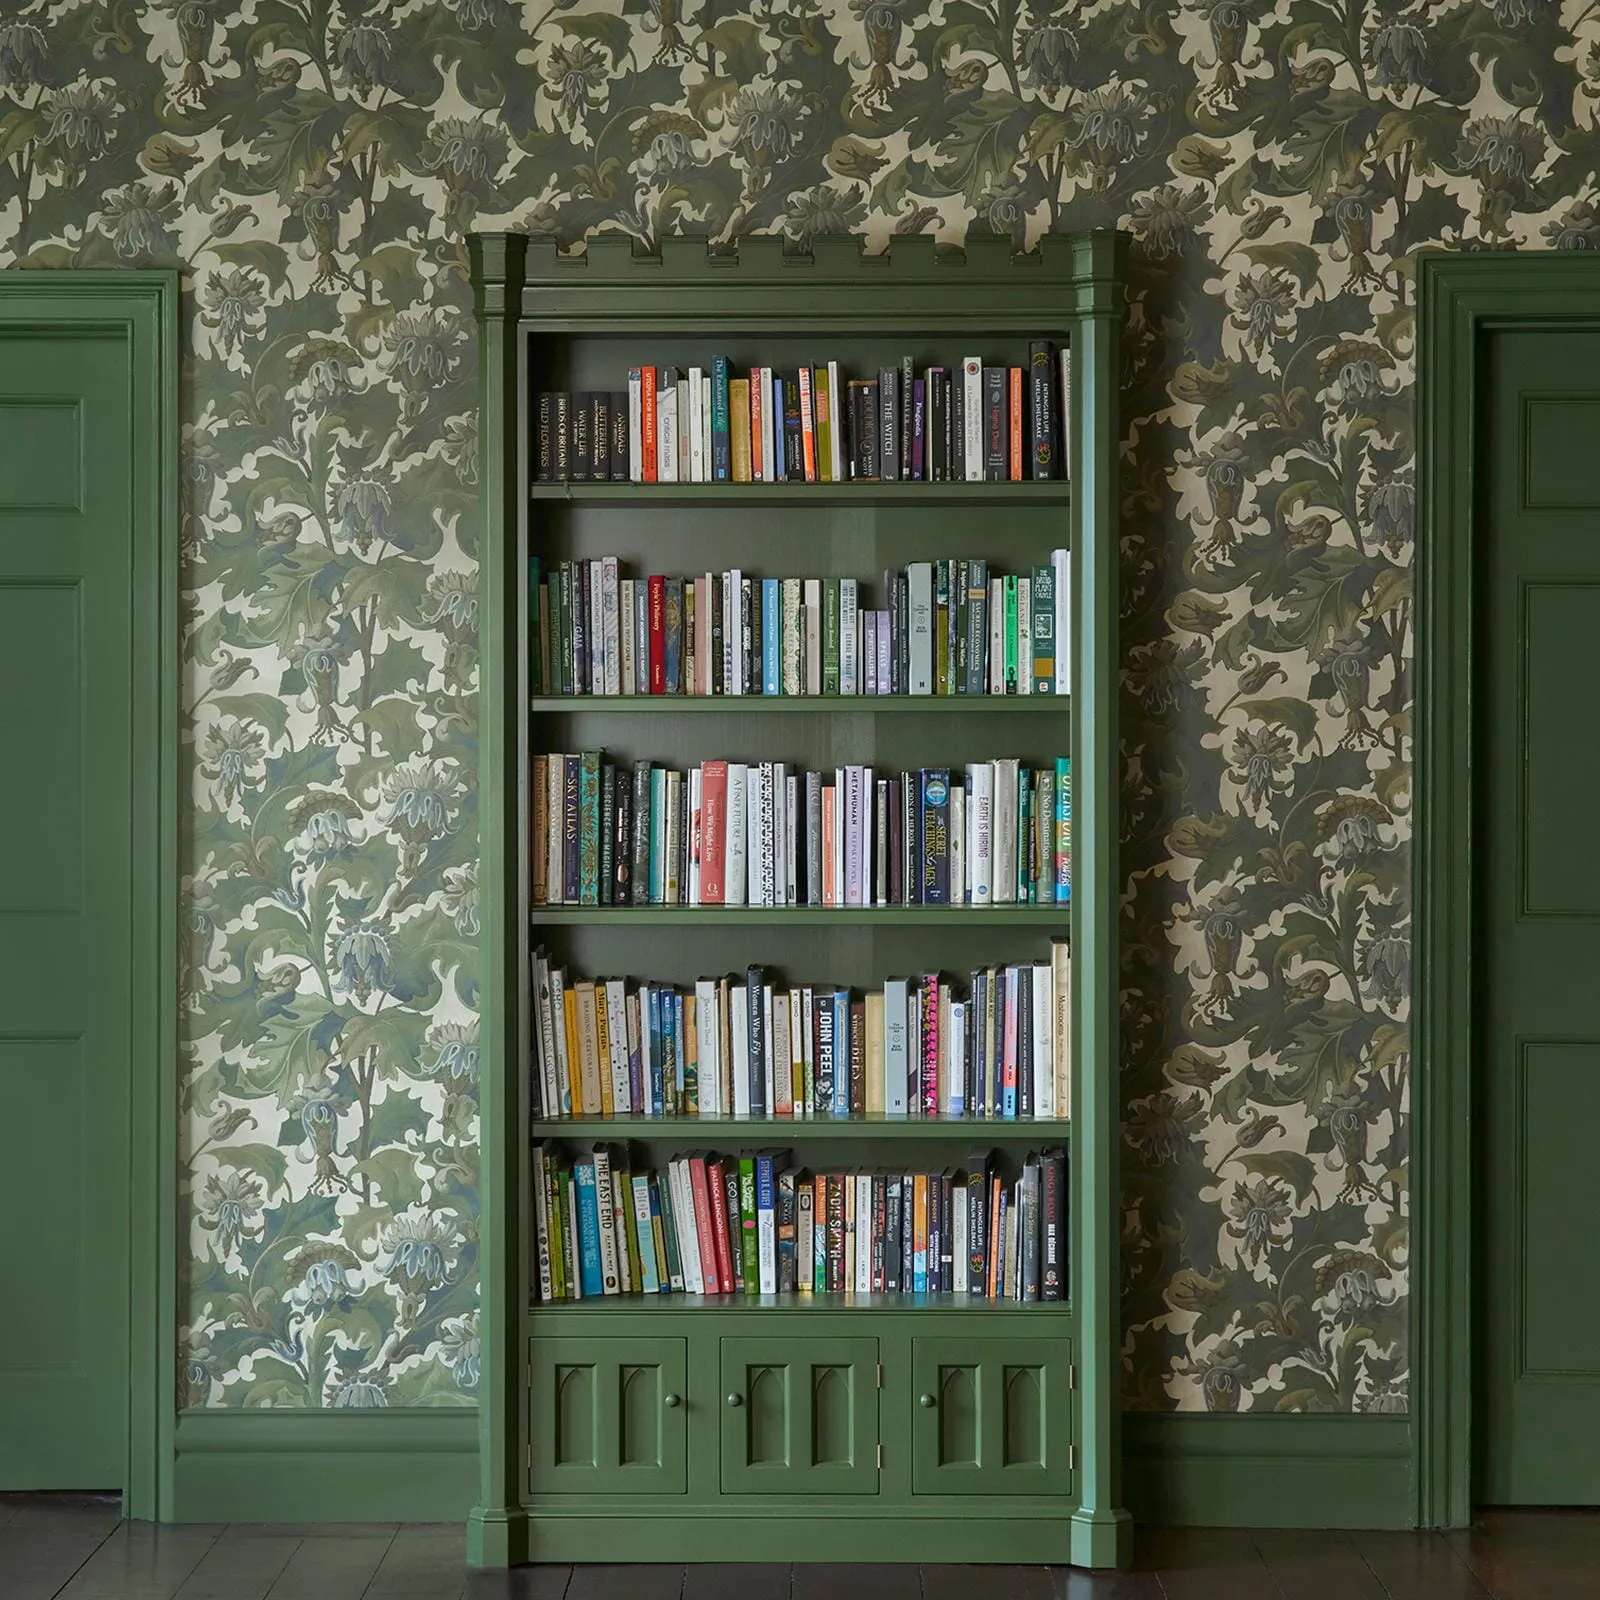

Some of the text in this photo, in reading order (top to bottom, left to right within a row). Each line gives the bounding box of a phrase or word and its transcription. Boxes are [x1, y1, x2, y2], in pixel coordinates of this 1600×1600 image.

[645, 373, 653, 397] UTOPIA
[716, 374, 725, 410] Enchanted
[800, 371, 811, 394] START
[801, 396, 812, 414] WITH
[541, 398, 549, 467] WILD FLOWERS
[558, 398, 567, 467] BIRDS OF BRITAIN
[578, 410, 587, 457] WATER LIFE
[599, 405, 608, 459] BUTTERFLIES
[617, 413, 626, 454] ANIMALS
[663, 417, 672, 444] critical
[884, 401, 893, 455] THE WITCH
[575, 626, 583, 649] GAIA
[535, 809, 543, 832] ATLAS
[567, 778, 577, 840] SKY ATLAS
[707, 815, 714, 826] We
[909, 808, 914, 818] OF
[979, 797, 988, 820] EARTH
[706, 827, 714, 846] Might
[733, 810, 742, 839] FUTURE
[1043, 795, 1051, 859] No Destination
[925, 808, 936, 886] TEACHINGS AGES
[936, 825, 946, 858] SECRET
[979, 832, 988, 858] HIRING
[751, 985, 761, 1055] Women Who Fly
[1057, 994, 1066, 1036] Mushrooms
[597, 991, 610, 1093] Mary Portas Rebuild
[775, 1037, 783, 1057] GOD
[820, 1010, 832, 1076] JOHN PEEL
[776, 1060, 784, 1103] DELUSION
[598, 1158, 609, 1177] THE
[761, 1160, 770, 1183] STEPHEN
[599, 1179, 610, 1205] EAST
[711, 1170, 723, 1234] PATRICK LENCIONI
[728, 1181, 738, 1198] GO
[762, 1190, 771, 1206] COVEY
[830, 1183, 841, 1217] ZADIE
[601, 1209, 612, 1229] END
[830, 1220, 841, 1258] SMITH
